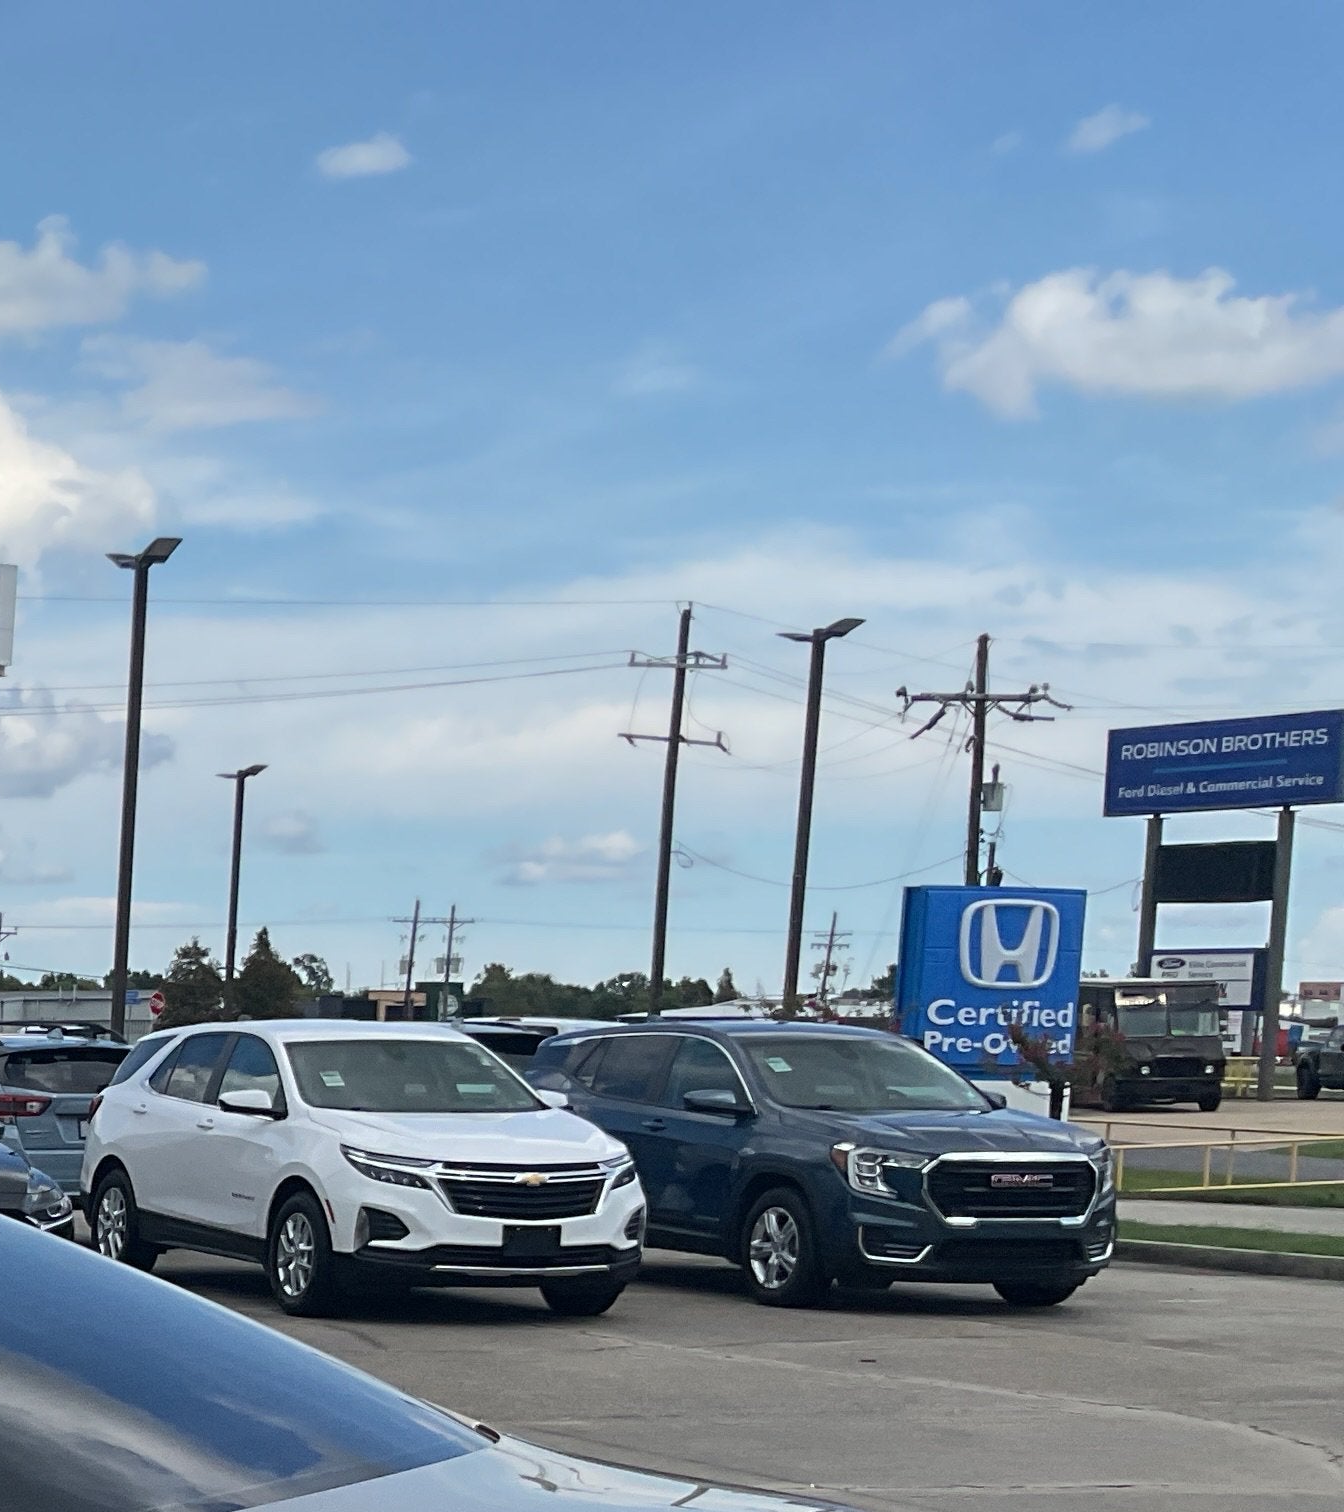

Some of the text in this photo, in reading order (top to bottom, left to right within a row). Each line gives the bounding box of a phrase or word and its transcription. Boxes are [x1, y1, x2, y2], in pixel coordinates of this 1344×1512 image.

[1121, 728, 1329, 761] ROBINSON BROTHERS
[1118, 773, 1324, 799] Ford Diesel & Commercial Service
[927, 999, 1074, 1028] Certified
